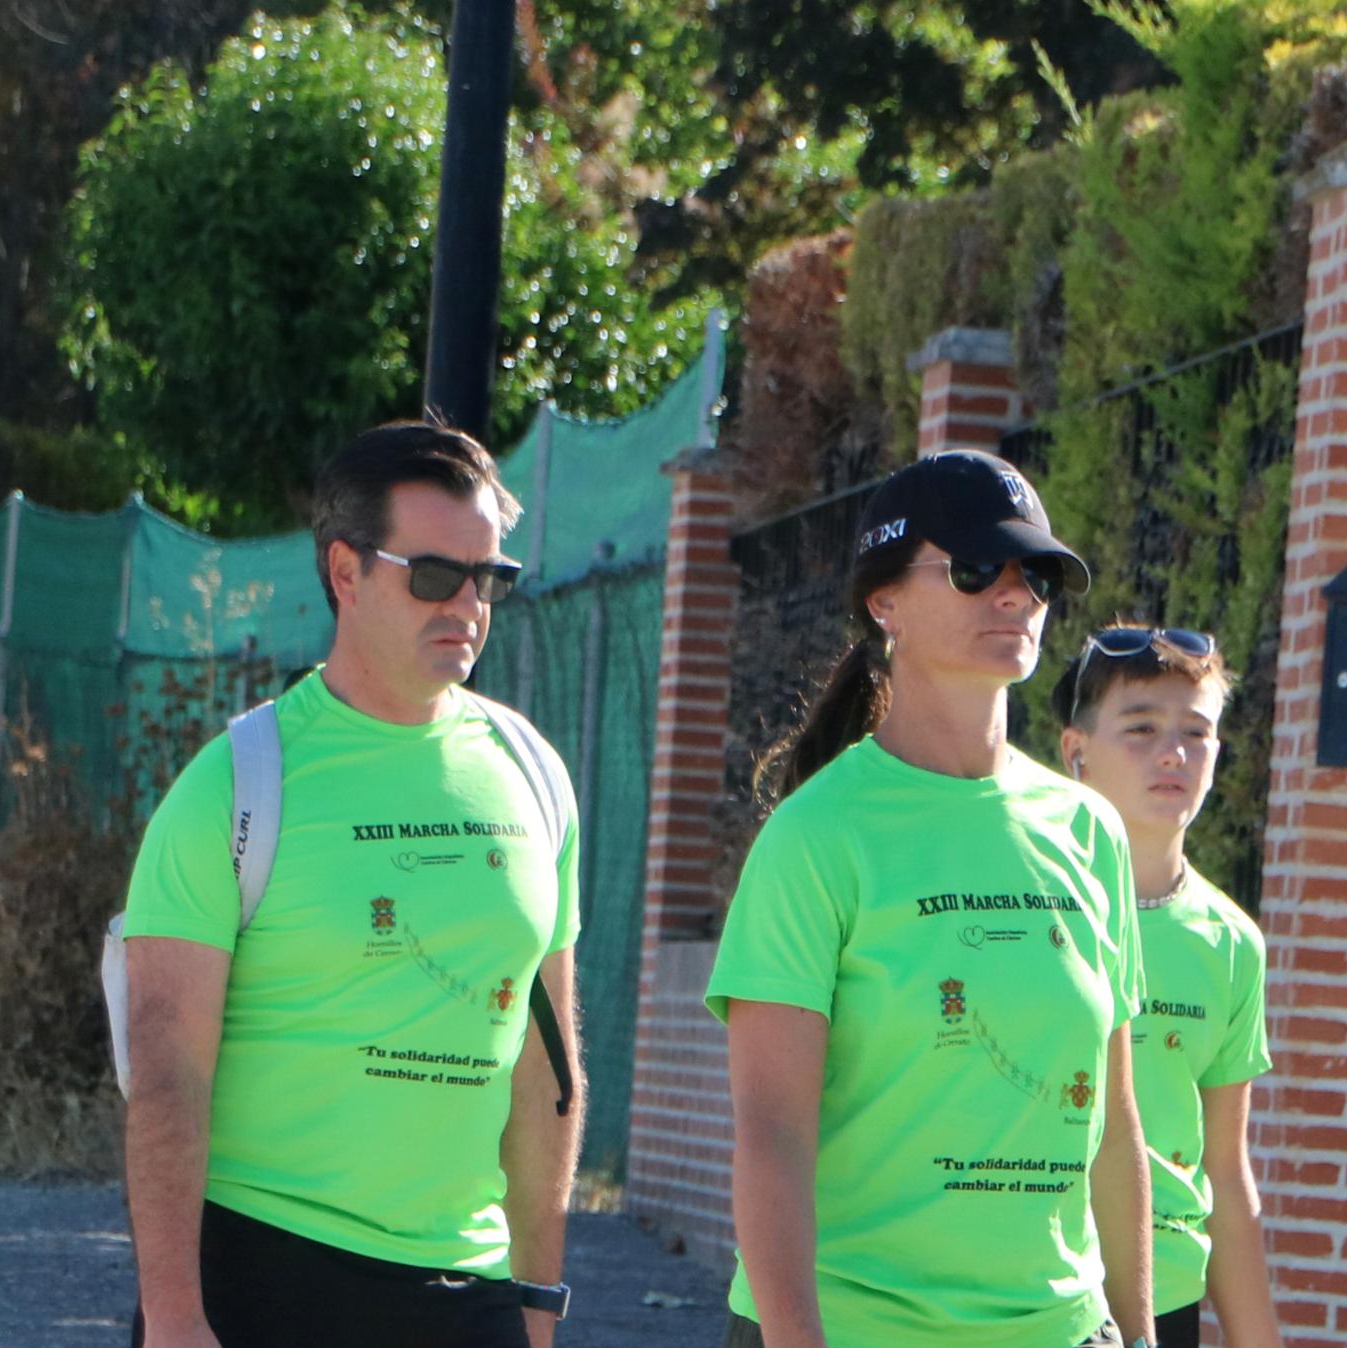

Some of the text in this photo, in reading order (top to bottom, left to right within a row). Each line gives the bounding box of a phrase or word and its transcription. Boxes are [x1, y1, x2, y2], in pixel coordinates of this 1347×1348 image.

[237, 810, 252, 856] CURL
[352, 821, 529, 841] XXIII MARCHA SOLIDARIA
[917, 894, 959, 917] XXIII
[961, 893, 1021, 911] MARCHA
[1151, 999, 1206, 1020] SOLIDARIA
[390, 1049, 470, 1066] solidaridad
[365, 1066, 428, 1082] cambiar
[431, 1073, 443, 1083] el
[968, 1158, 1046, 1171] solidaridad
[944, 1180, 1005, 1192] cambiar
[1008, 1181, 1021, 1192] el
